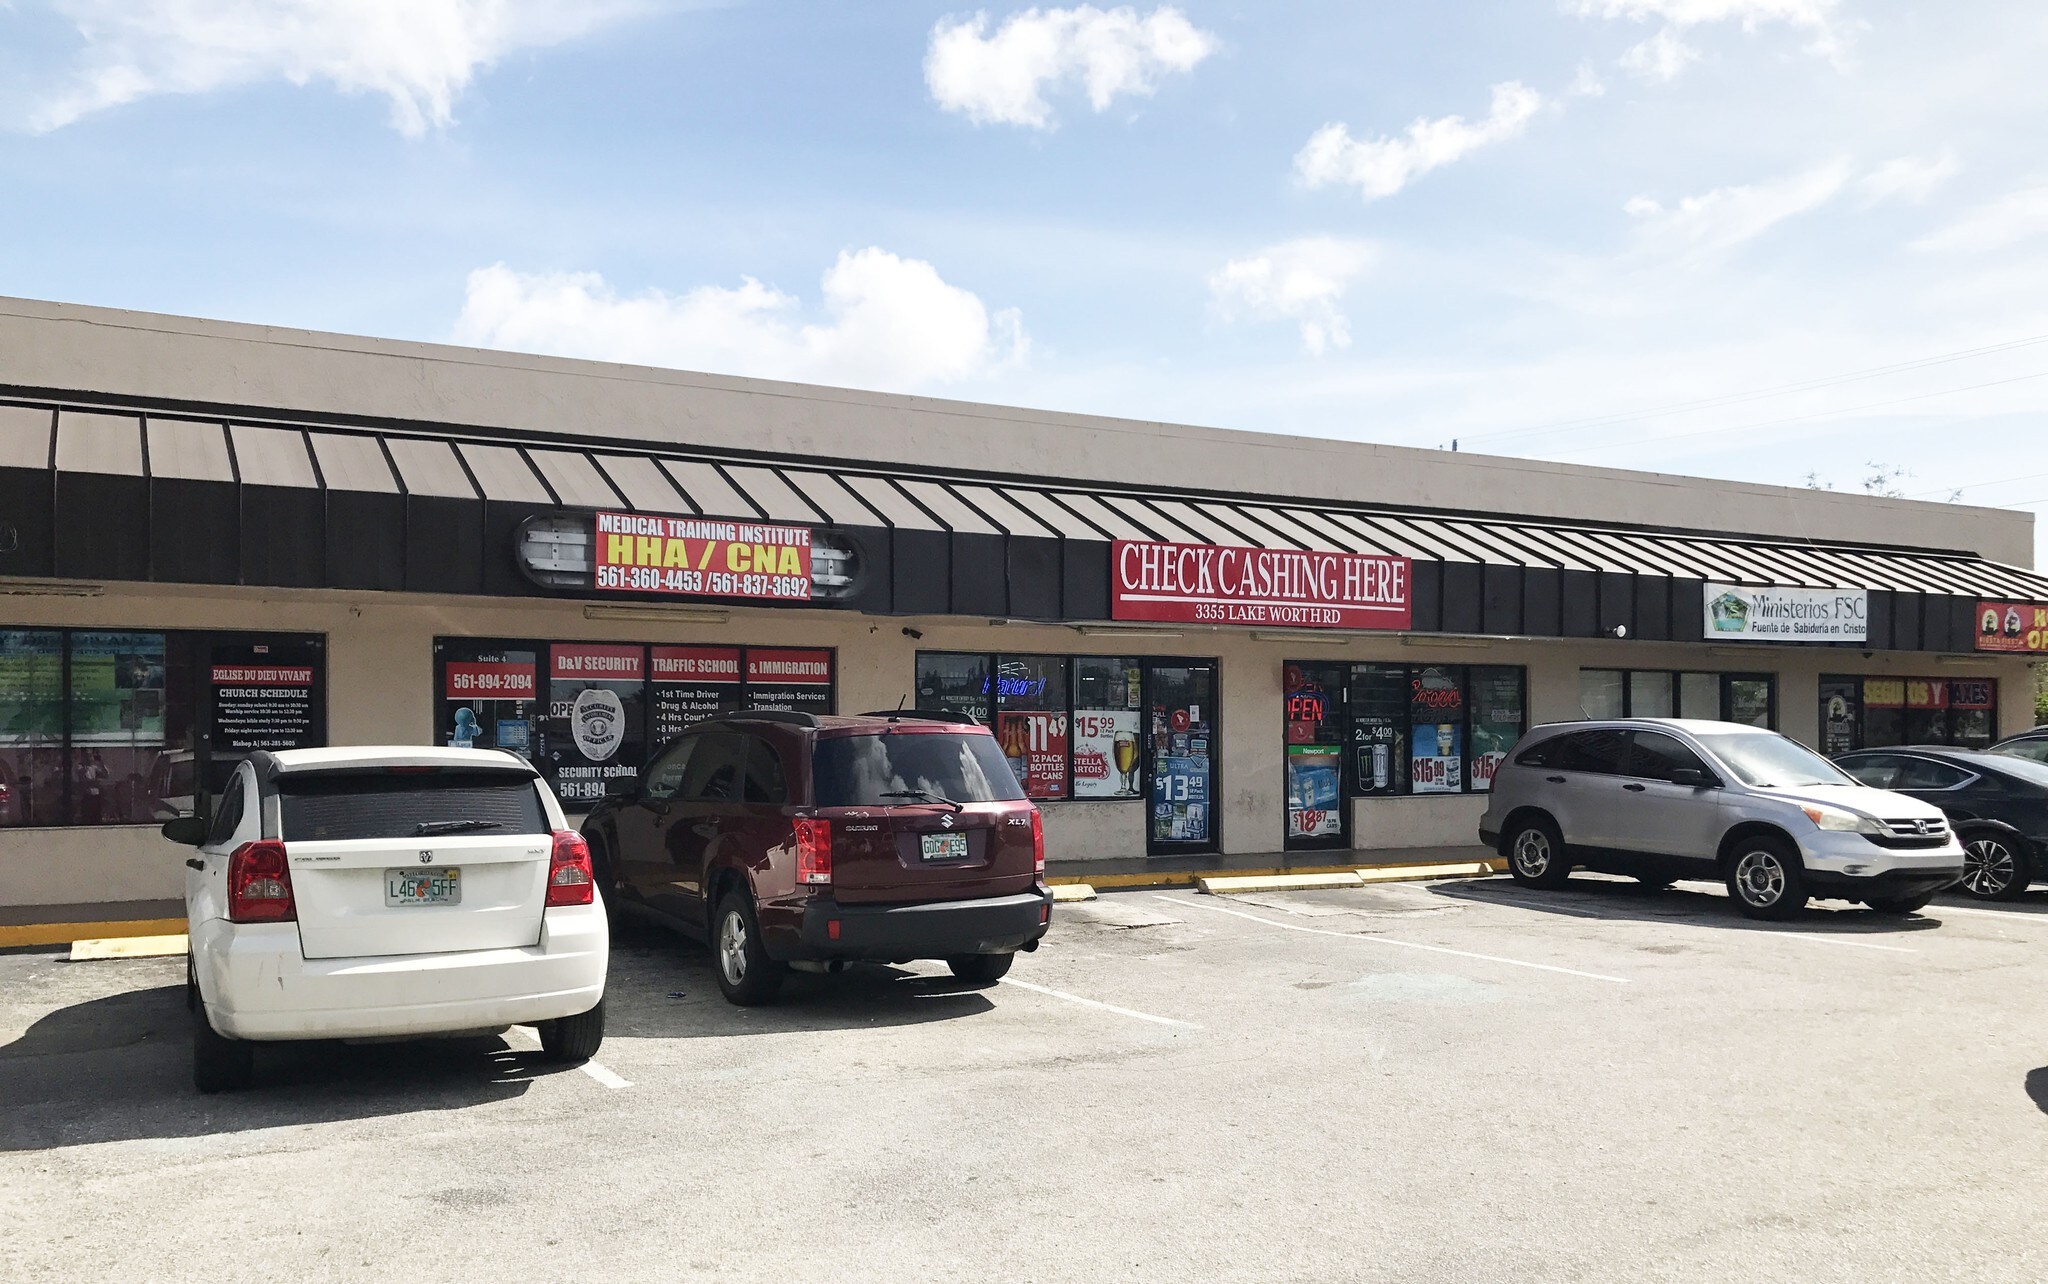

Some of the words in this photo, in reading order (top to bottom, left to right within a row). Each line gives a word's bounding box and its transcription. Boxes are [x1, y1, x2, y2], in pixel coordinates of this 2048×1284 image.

[599, 514, 664, 536] MEDICAL
[668, 520, 735, 542] TRAINING
[740, 525, 809, 546] INSTITUTE
[607, 534, 689, 569] HHA
[698, 540, 717, 570] /
[726, 542, 801, 575] CNA
[597, 565, 702, 592] 561-360-4453
[1120, 543, 1215, 594] CHECK
[1343, 558, 1405, 603] HERE
[1752, 594, 1829, 619] Ministerios
[1835, 597, 1865, 619] FSC
[1195, 604, 1225, 620] 3355
[1228, 605, 1266, 622] LAKE
[1269, 606, 1322, 623] WORTH
[1752, 621, 1779, 633] Fuente
[1780, 622, 1790, 633] de
[1830, 625, 1839, 633] en
[1843, 623, 1866, 634] Cristo
[478, 655, 499, 663] Suite
[558, 656, 582, 670] D&V
[585, 656, 639, 671] SECURITY
[653, 658, 695, 672] TRAFFIC
[697, 659, 739, 674] SCHOOL
[750, 662, 758, 674] &
[760, 661, 827, 675] IMMIGRATION
[213, 669, 243, 680] EGLISE
[244, 669, 256, 680] DU
[258, 670, 277, 681] DIEU
[278, 670, 311, 681] VIVANT
[453, 673, 532, 689] 561-894-2094
[220, 688, 258, 698] CHURCH
[260, 689, 308, 698] SCHEDULE
[661, 689, 673, 698] 1st
[675, 690, 695, 698] Time
[697, 690, 719, 699] Driver
[753, 691, 795, 702] Immigration
[796, 692, 826, 701] Services
[1931, 682, 1942, 704] Y
[551, 702, 573, 717] OPE
[661, 701, 679, 712] Drug
[681, 701, 688, 710] &
[690, 701, 719, 710] Alcohol
[754, 703, 792, 711] Translation
[661, 713, 666, 721] 4
[668, 713, 682, 721] Hrs
[684, 713, 705, 721] Court
[661, 724, 666, 733] 8
[668, 725, 682, 733] Hrs
[1355, 729, 1362, 740] 2
[1362, 733, 1372, 741] for
[1031, 754, 1040, 762] 12
[1041, 754, 1063, 762] PACK
[1074, 757, 1102, 765] STELLA
[559, 766, 601, 778] SECURITY
[604, 766, 638, 777] SCHOOL
[1030, 763, 1064, 772] BOTTLES
[1074, 765, 1102, 773] ARTOIS
[1041, 772, 1063, 780] CANS
[560, 782, 606, 797] 561-894
[1007, 817, 1026, 826] XL7
[845, 824, 878, 832] SUZUKI
[390, 880, 415, 898] L46
[432, 879, 457, 896] 5FF
